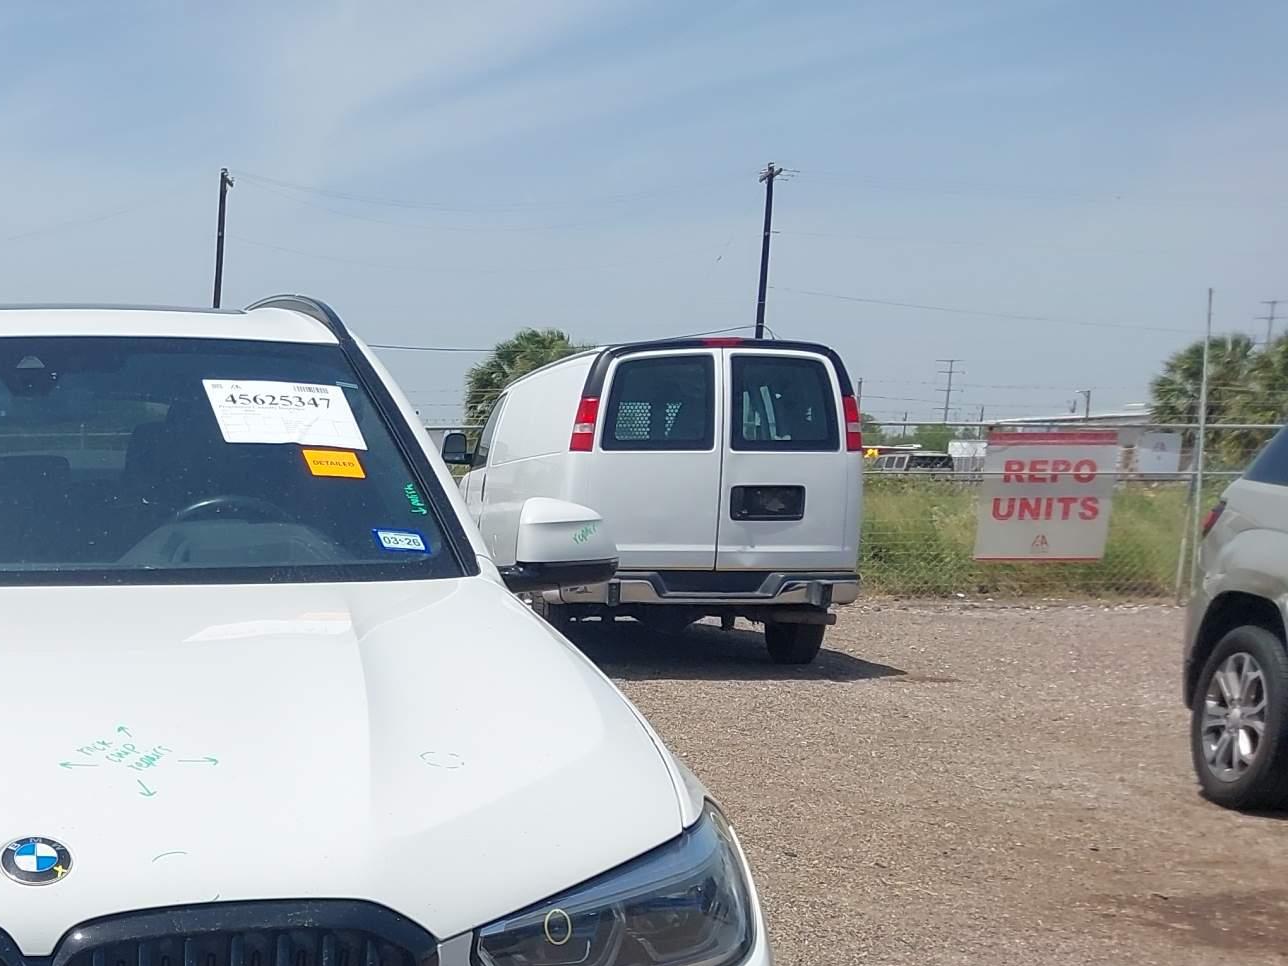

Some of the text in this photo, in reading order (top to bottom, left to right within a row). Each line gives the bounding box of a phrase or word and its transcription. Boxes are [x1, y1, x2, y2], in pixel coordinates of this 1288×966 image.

[224, 393, 332, 410] 45625347
[312, 459, 356, 468] DETAILED
[1003, 459, 1098, 484] REPO
[991, 497, 1101, 521] UNITS
